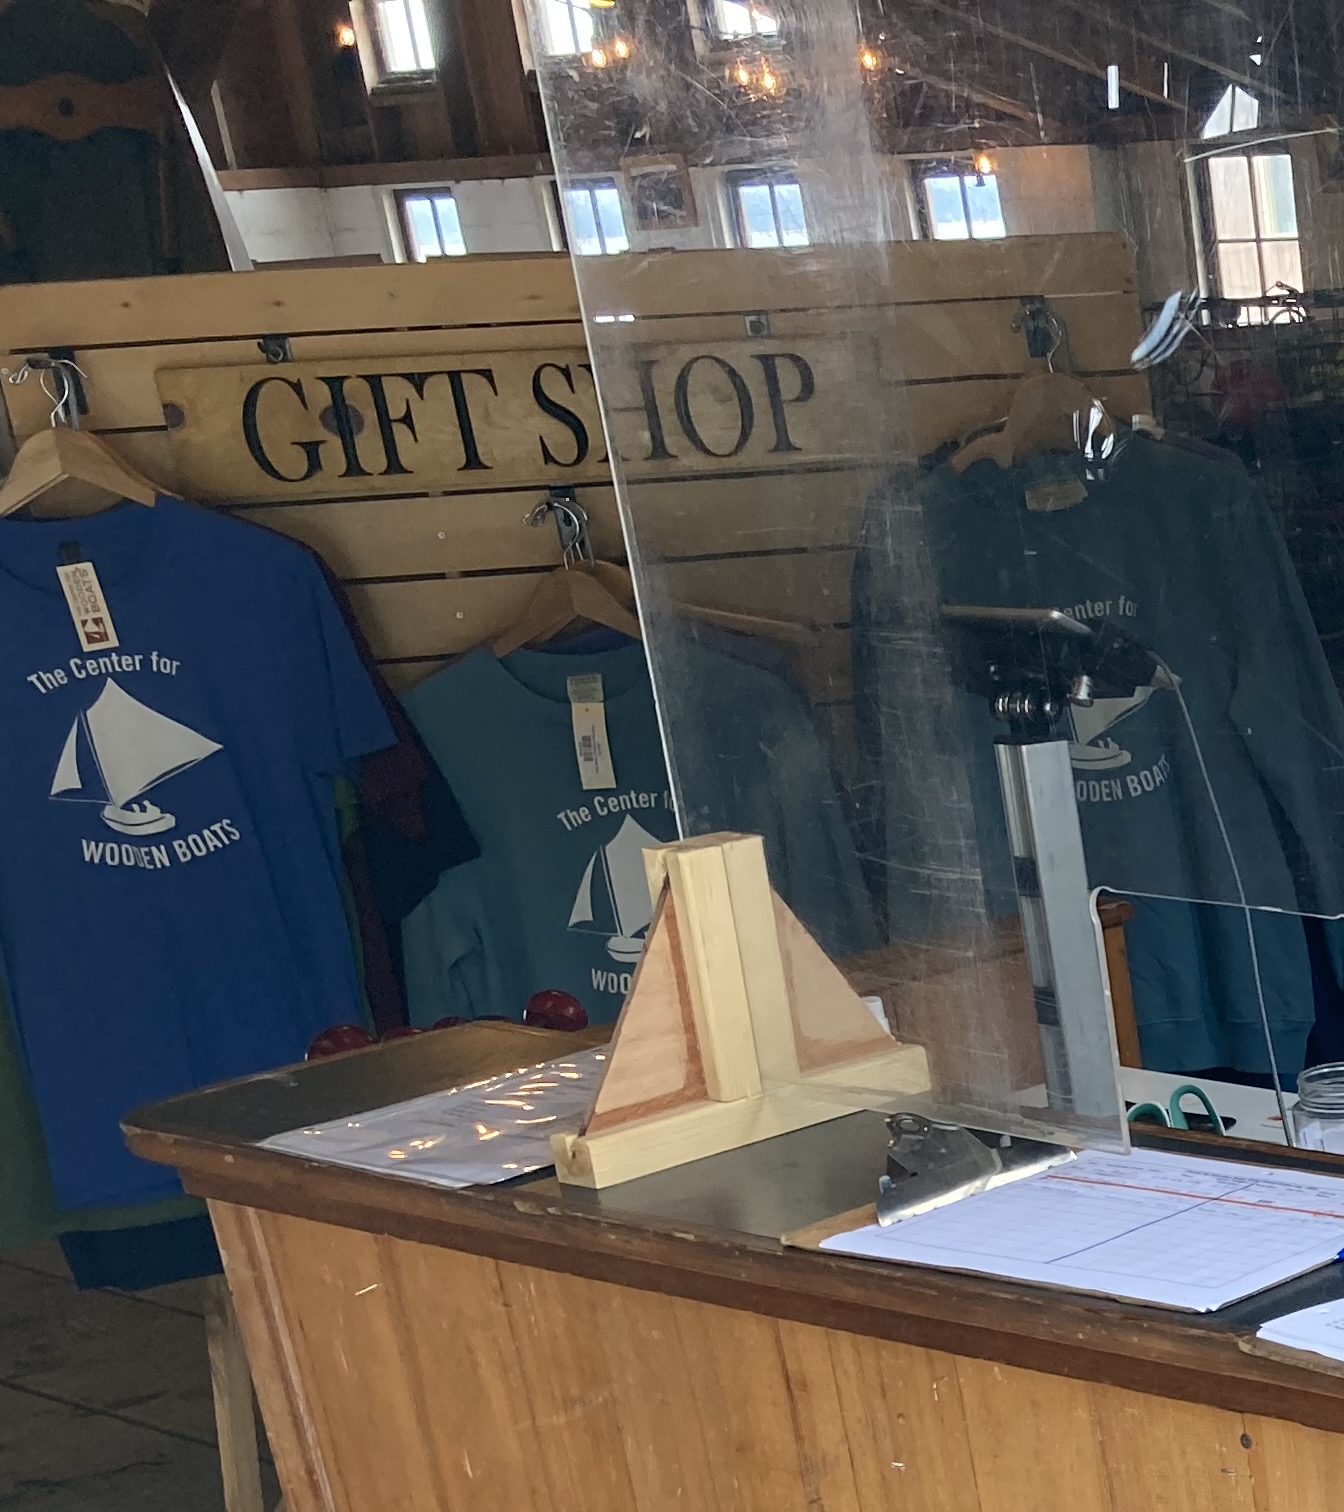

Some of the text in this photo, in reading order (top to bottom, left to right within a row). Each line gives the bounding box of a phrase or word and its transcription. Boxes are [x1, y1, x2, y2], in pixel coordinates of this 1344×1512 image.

[242, 353, 815, 483] GIFT SHOP
[80, 568, 100, 613] BOATS
[1062, 599, 1112, 621] enter
[27, 651, 181, 695] The Center for
[557, 805, 592, 831] The
[594, 790, 658, 816] Center
[81, 818, 241, 870] WOODEN BOATS
